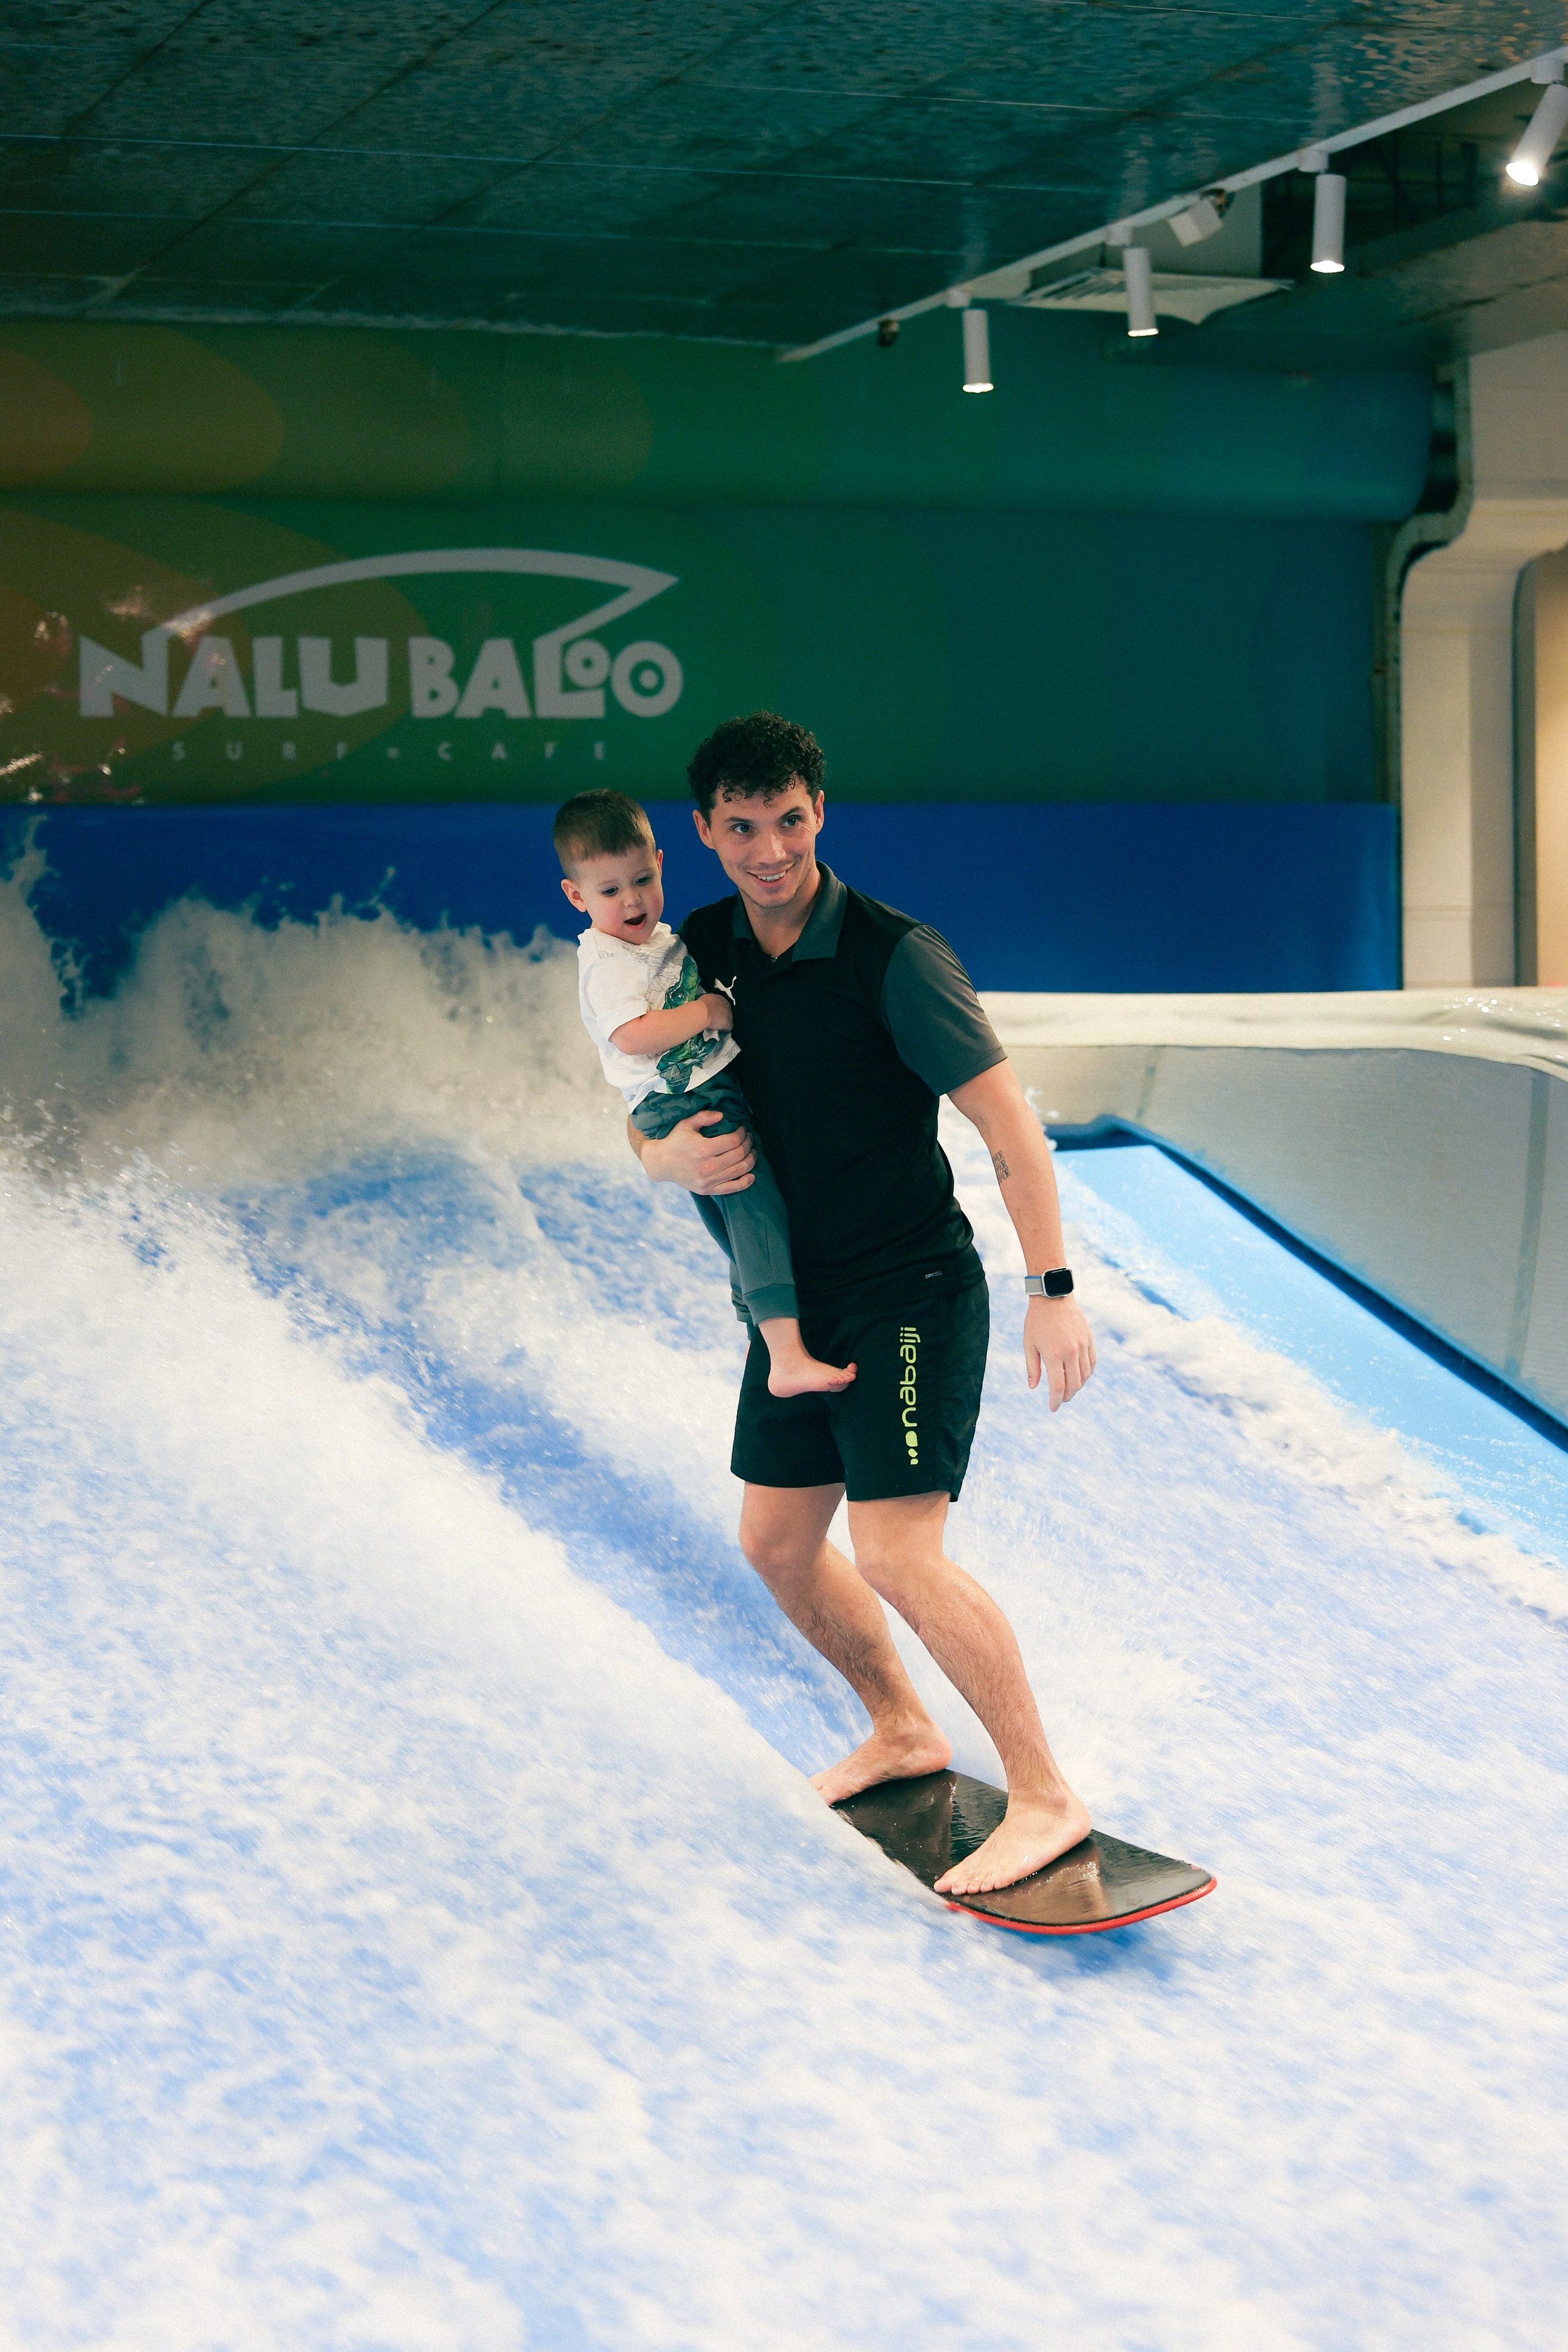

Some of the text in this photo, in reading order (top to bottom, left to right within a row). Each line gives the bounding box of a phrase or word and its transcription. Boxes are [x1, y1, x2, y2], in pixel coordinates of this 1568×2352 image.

[79, 635, 684, 718] NALU BALOO
[172, 741, 606, 761] SURF CAFE
[900, 1327, 921, 1427] nabaiji
